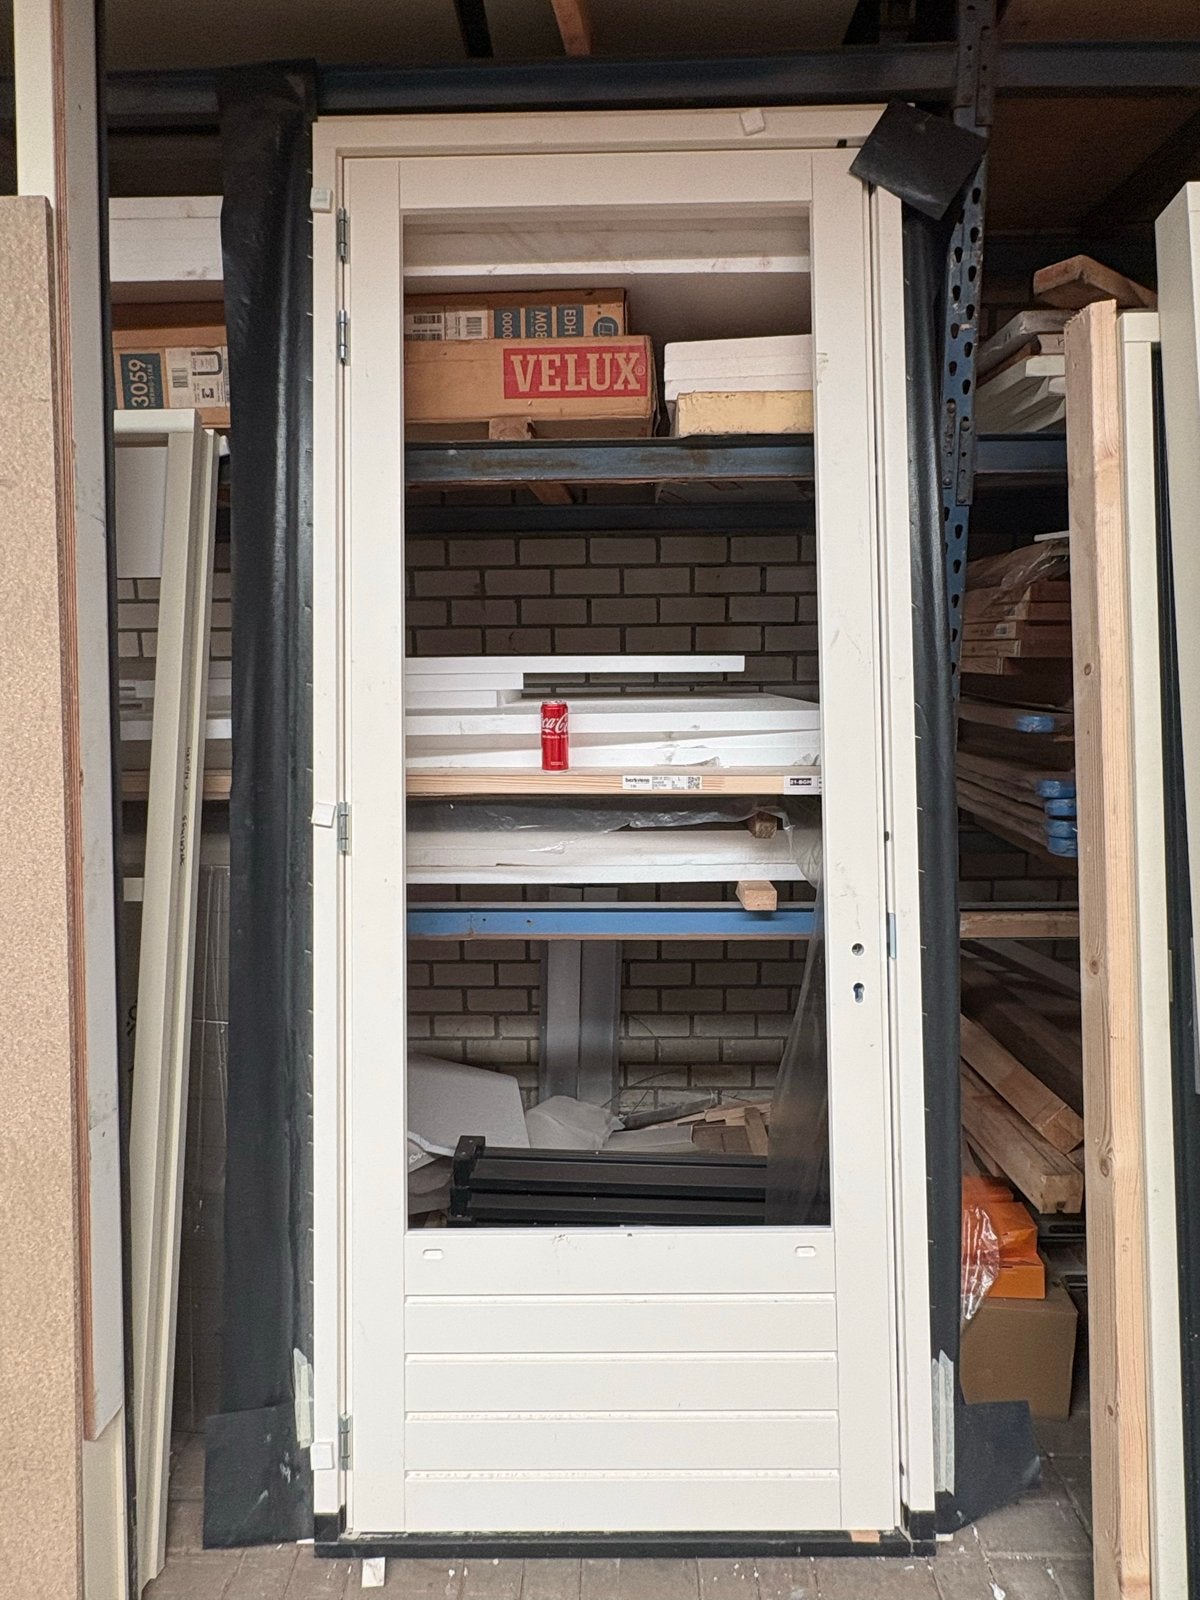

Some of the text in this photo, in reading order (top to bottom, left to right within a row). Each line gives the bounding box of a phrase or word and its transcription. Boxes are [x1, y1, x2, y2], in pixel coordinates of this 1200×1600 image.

[502, 312, 513, 338] 0000
[564, 309, 577, 335] EDH
[128, 359, 149, 407] 3059
[510, 352, 641, 392] VELUX
